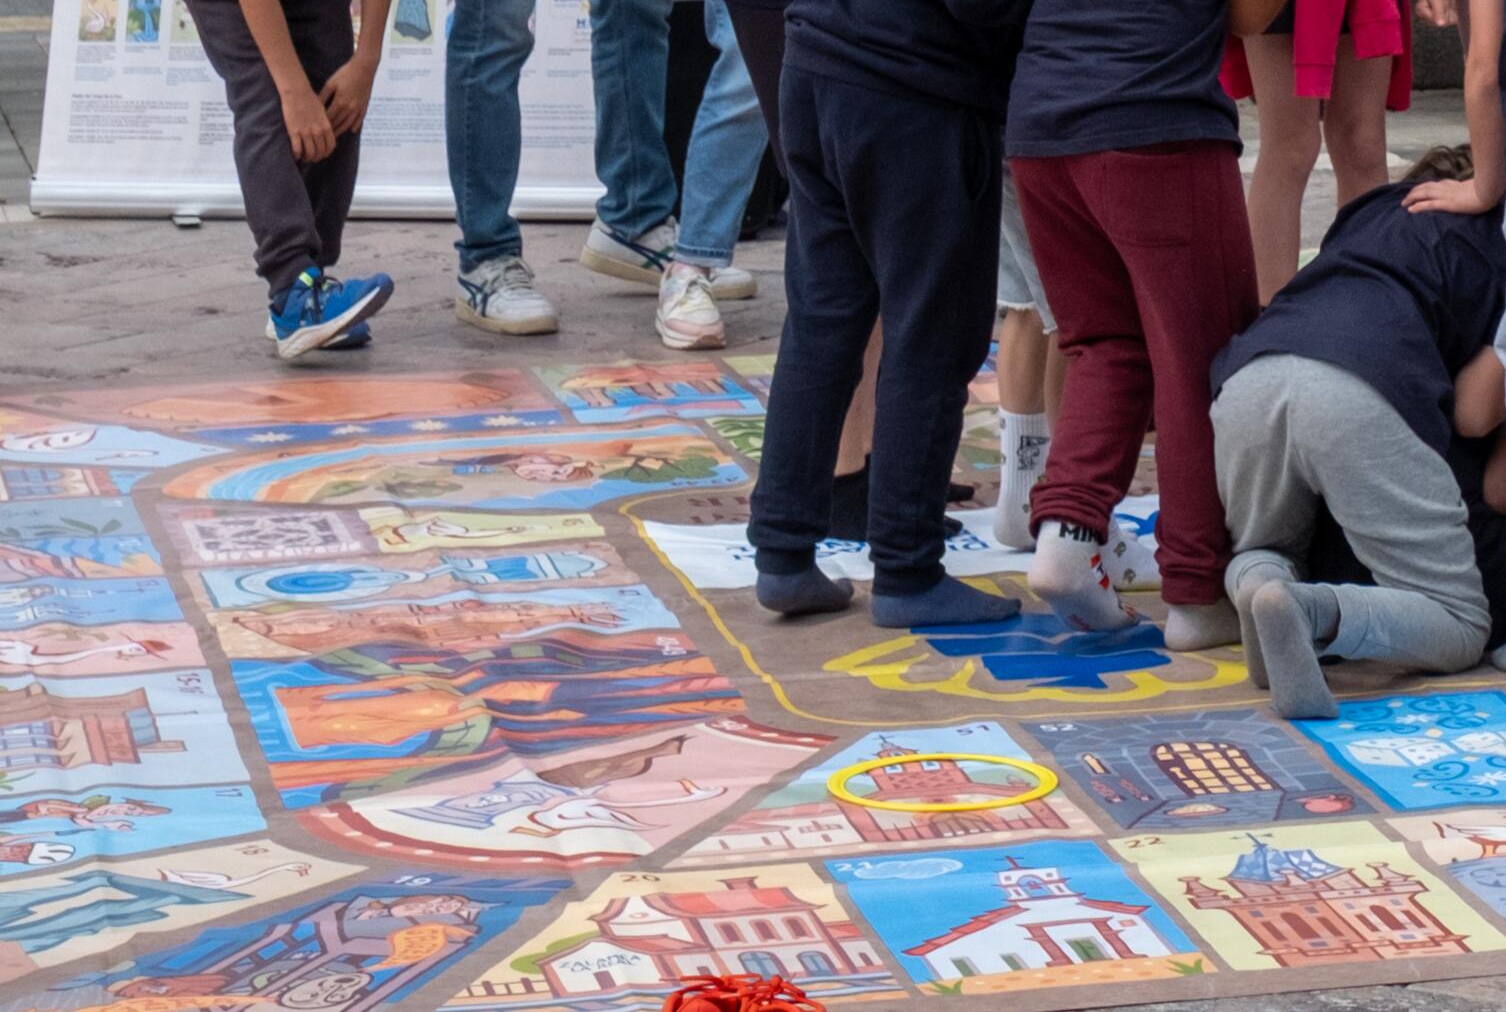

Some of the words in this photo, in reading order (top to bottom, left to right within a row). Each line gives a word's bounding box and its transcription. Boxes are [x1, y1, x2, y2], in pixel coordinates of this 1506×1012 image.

[1124, 836, 1165, 849] 22
[834, 860, 874, 872] 21
[394, 874, 432, 887] 19
[620, 872, 661, 884] 20
